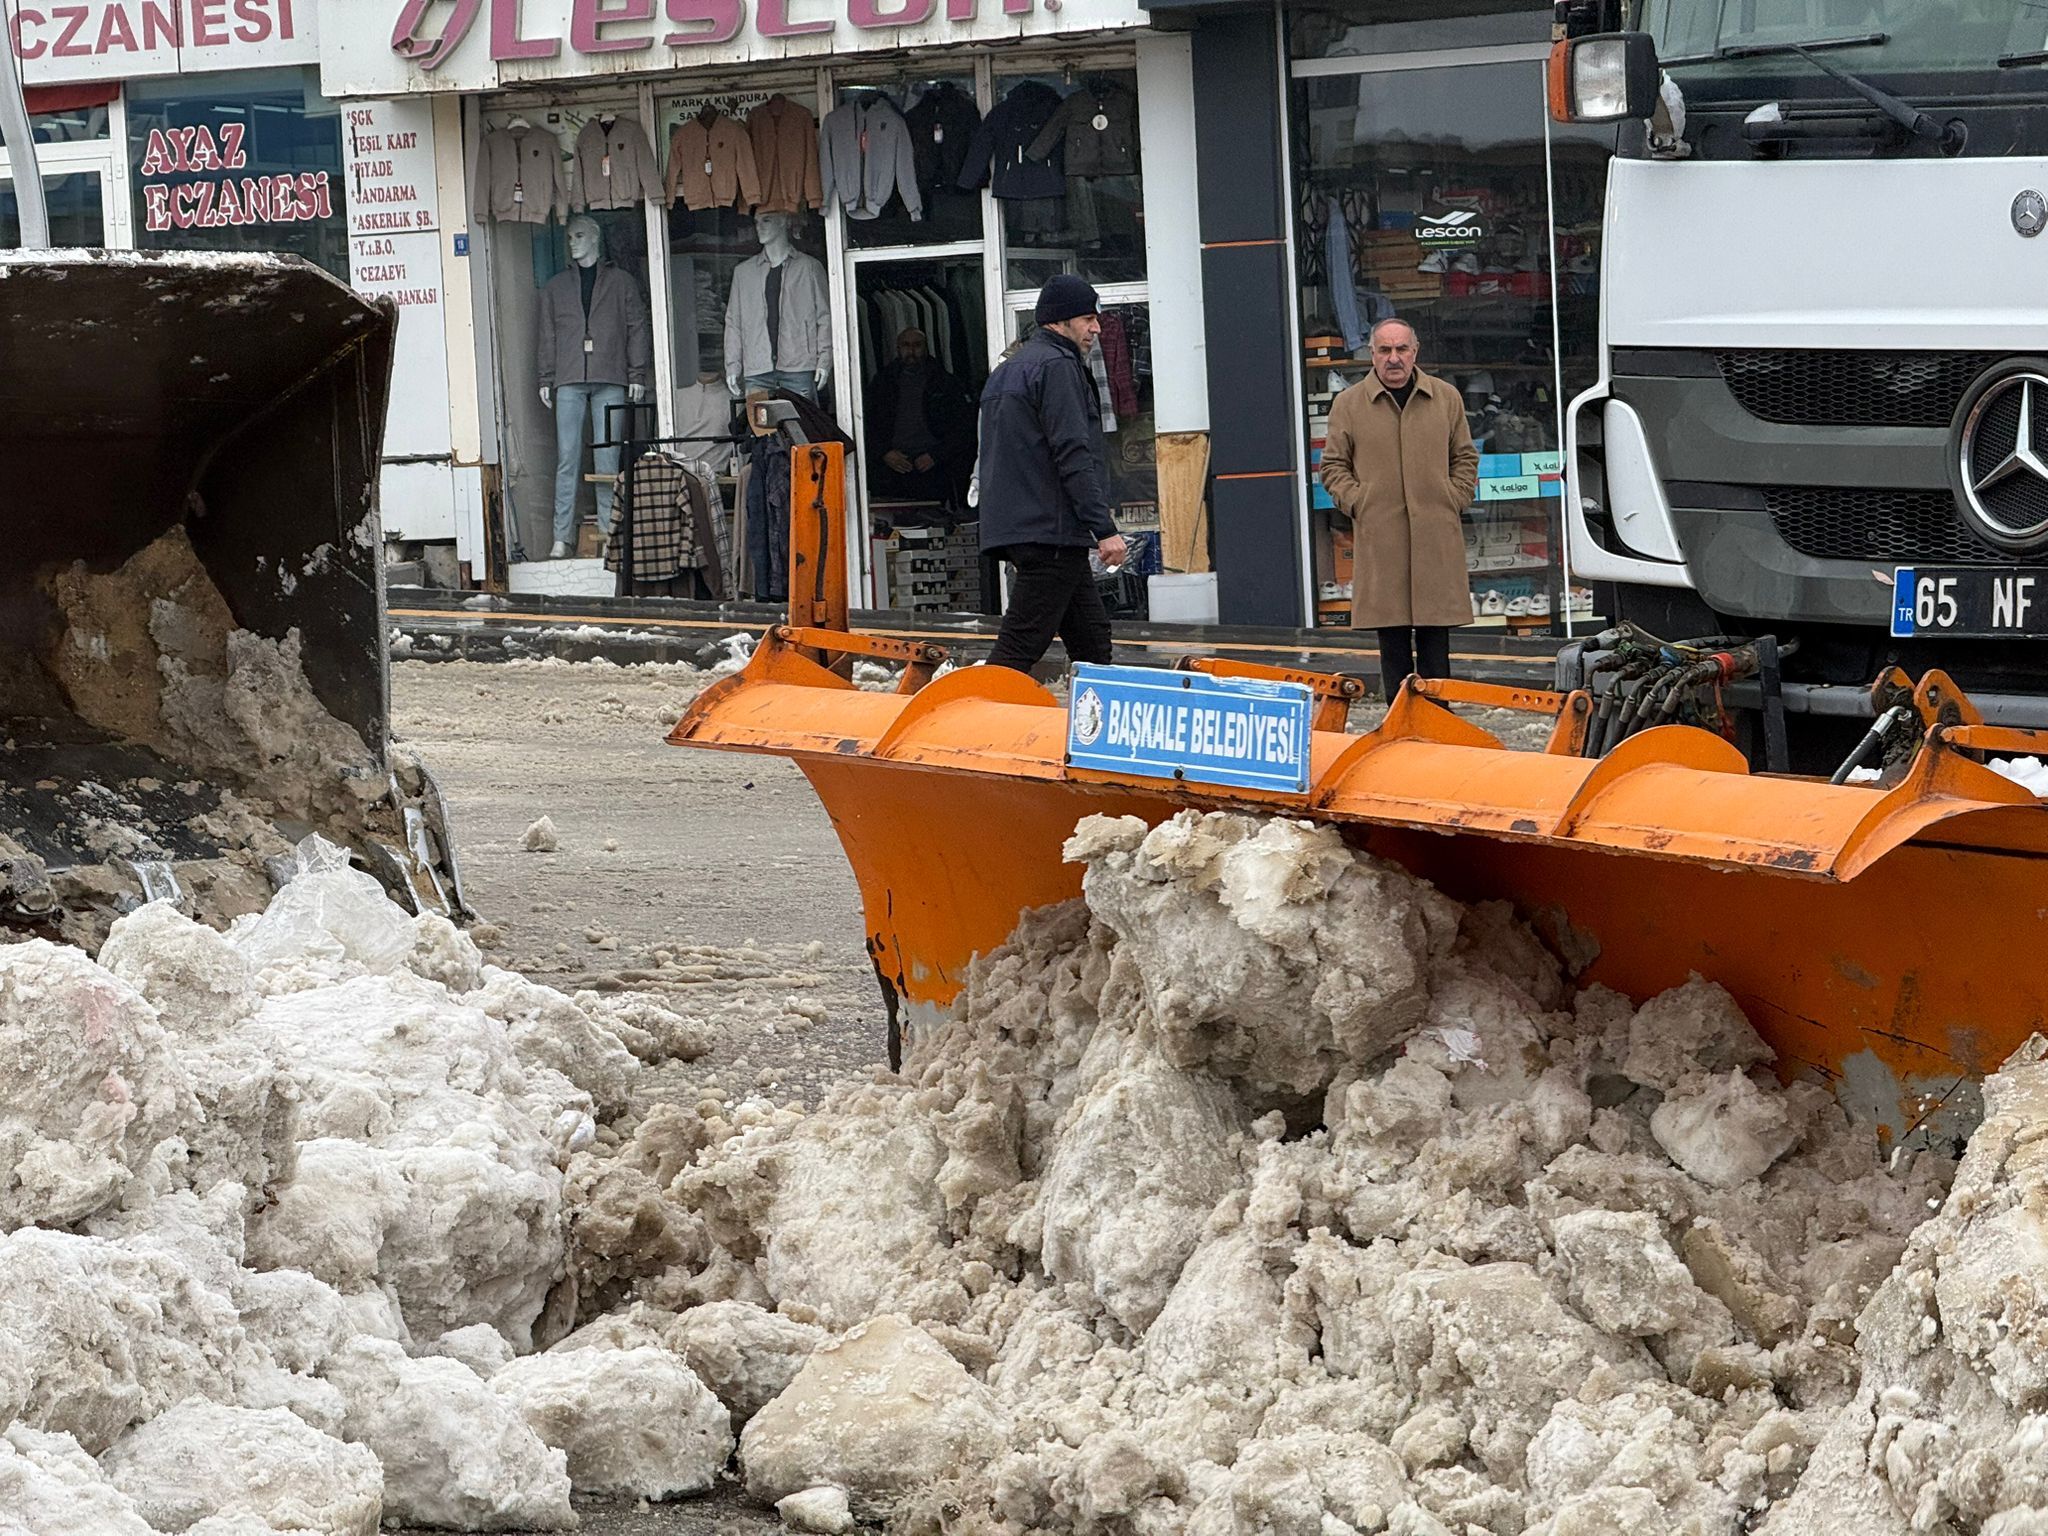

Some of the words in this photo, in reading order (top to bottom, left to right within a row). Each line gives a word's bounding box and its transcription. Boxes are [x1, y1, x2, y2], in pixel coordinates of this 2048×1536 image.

[671, 98, 711, 109] MARKA
[350, 109, 374, 126] SGK
[141, 123, 246, 175] AYAZ
[386, 132, 417, 151] KART
[397, 288, 437, 305] BANKASI
[1915, 577, 1958, 628] 65
[1992, 577, 2036, 629] NF
[1898, 607, 1913, 622] TR
[1107, 699, 1188, 759] BAŞKALE
[1190, 702, 1296, 765] BELEDİYESİ
